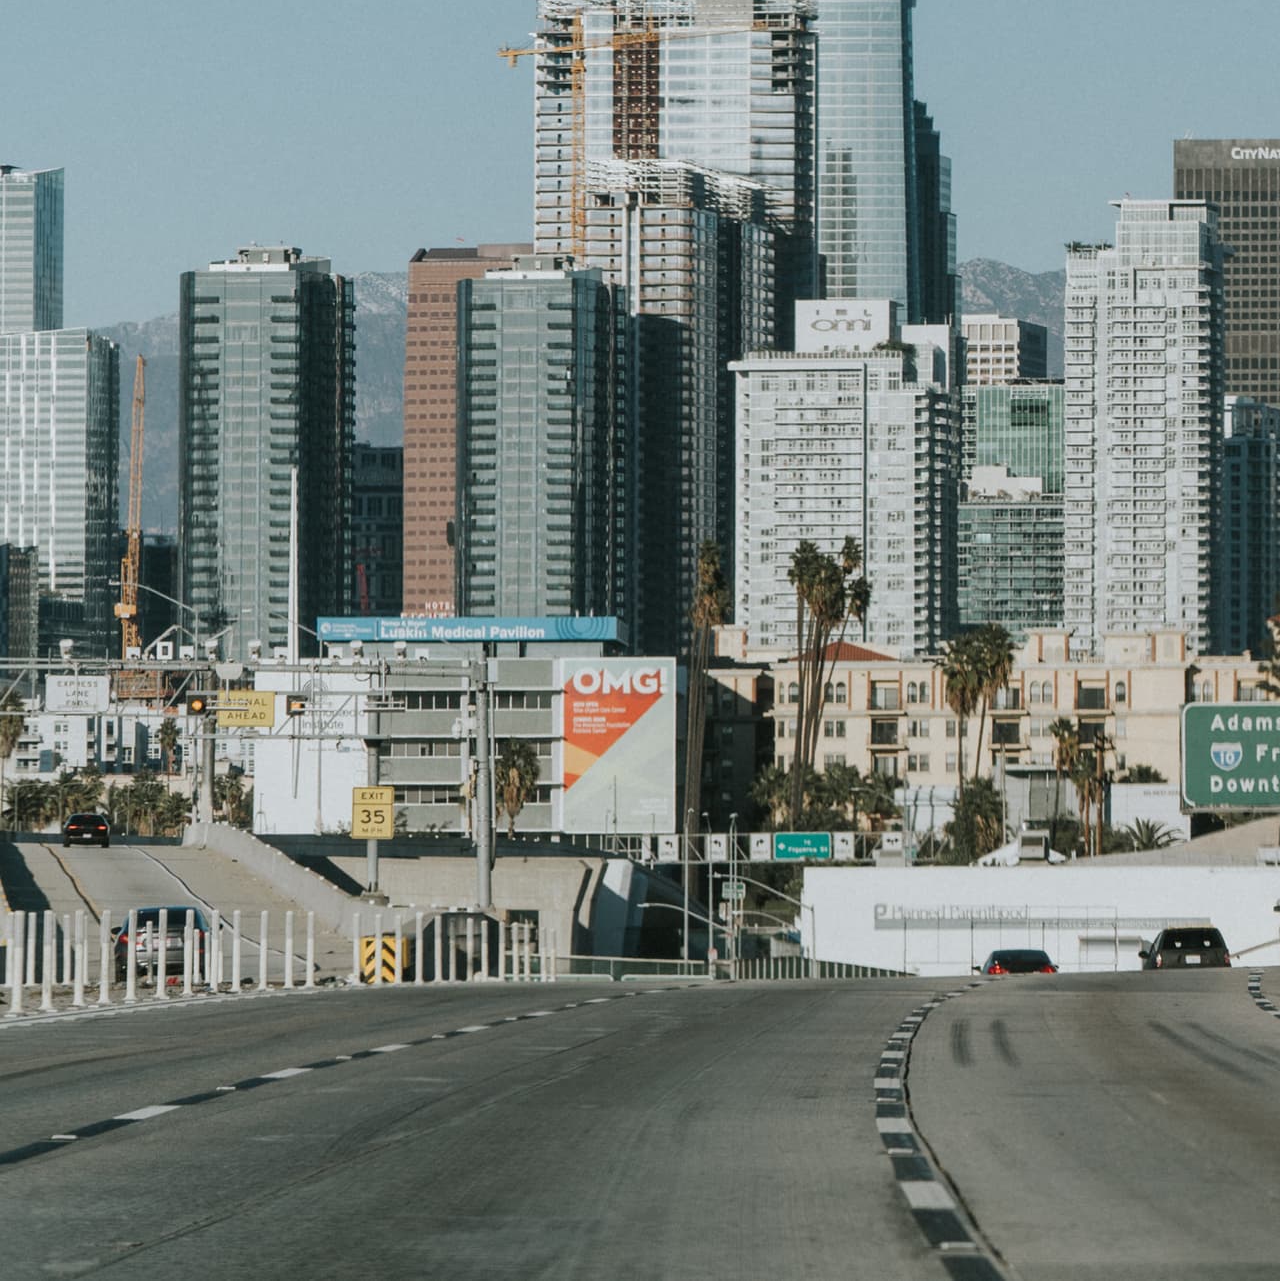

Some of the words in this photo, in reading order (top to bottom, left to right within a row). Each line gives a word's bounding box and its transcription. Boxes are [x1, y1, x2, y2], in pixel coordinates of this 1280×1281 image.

[381, 625, 427, 639] Luskin
[431, 625, 485, 639] Medical
[490, 625, 546, 639] Pavilion
[573, 668, 669, 695] OMG!
[227, 712, 267, 720] AHEAD
[1220, 750, 1234, 765] 10
[361, 792, 384, 800] EXIT
[360, 809, 385, 825] 35
